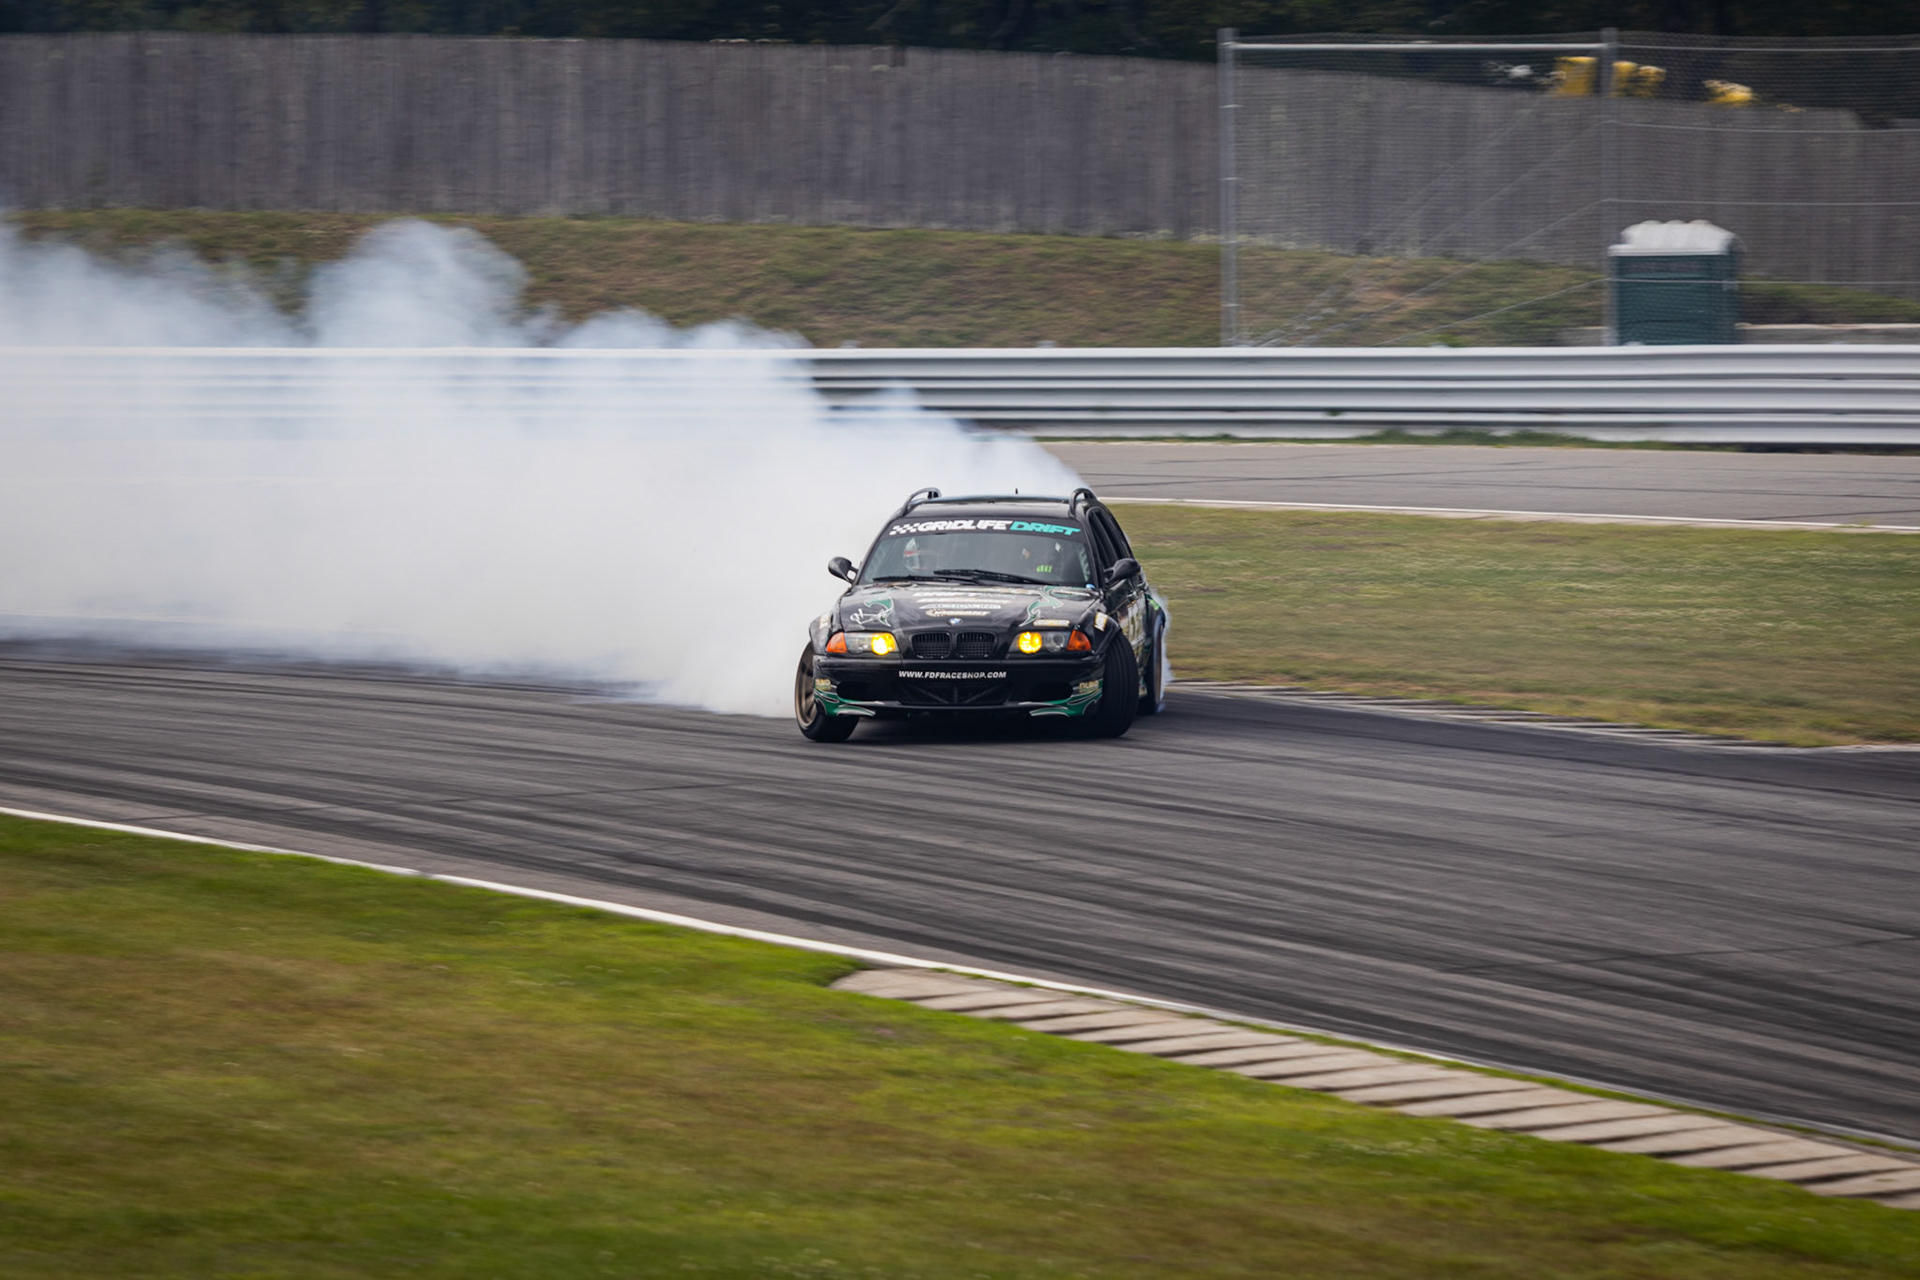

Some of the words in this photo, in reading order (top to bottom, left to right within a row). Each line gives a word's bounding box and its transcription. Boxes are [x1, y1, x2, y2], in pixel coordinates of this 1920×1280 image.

[917, 519, 1013, 531] GRIDLIFE
[1010, 520, 1081, 536] DRIFT
[898, 670, 1007, 680] WWW.FDFRACESHOP.COM
